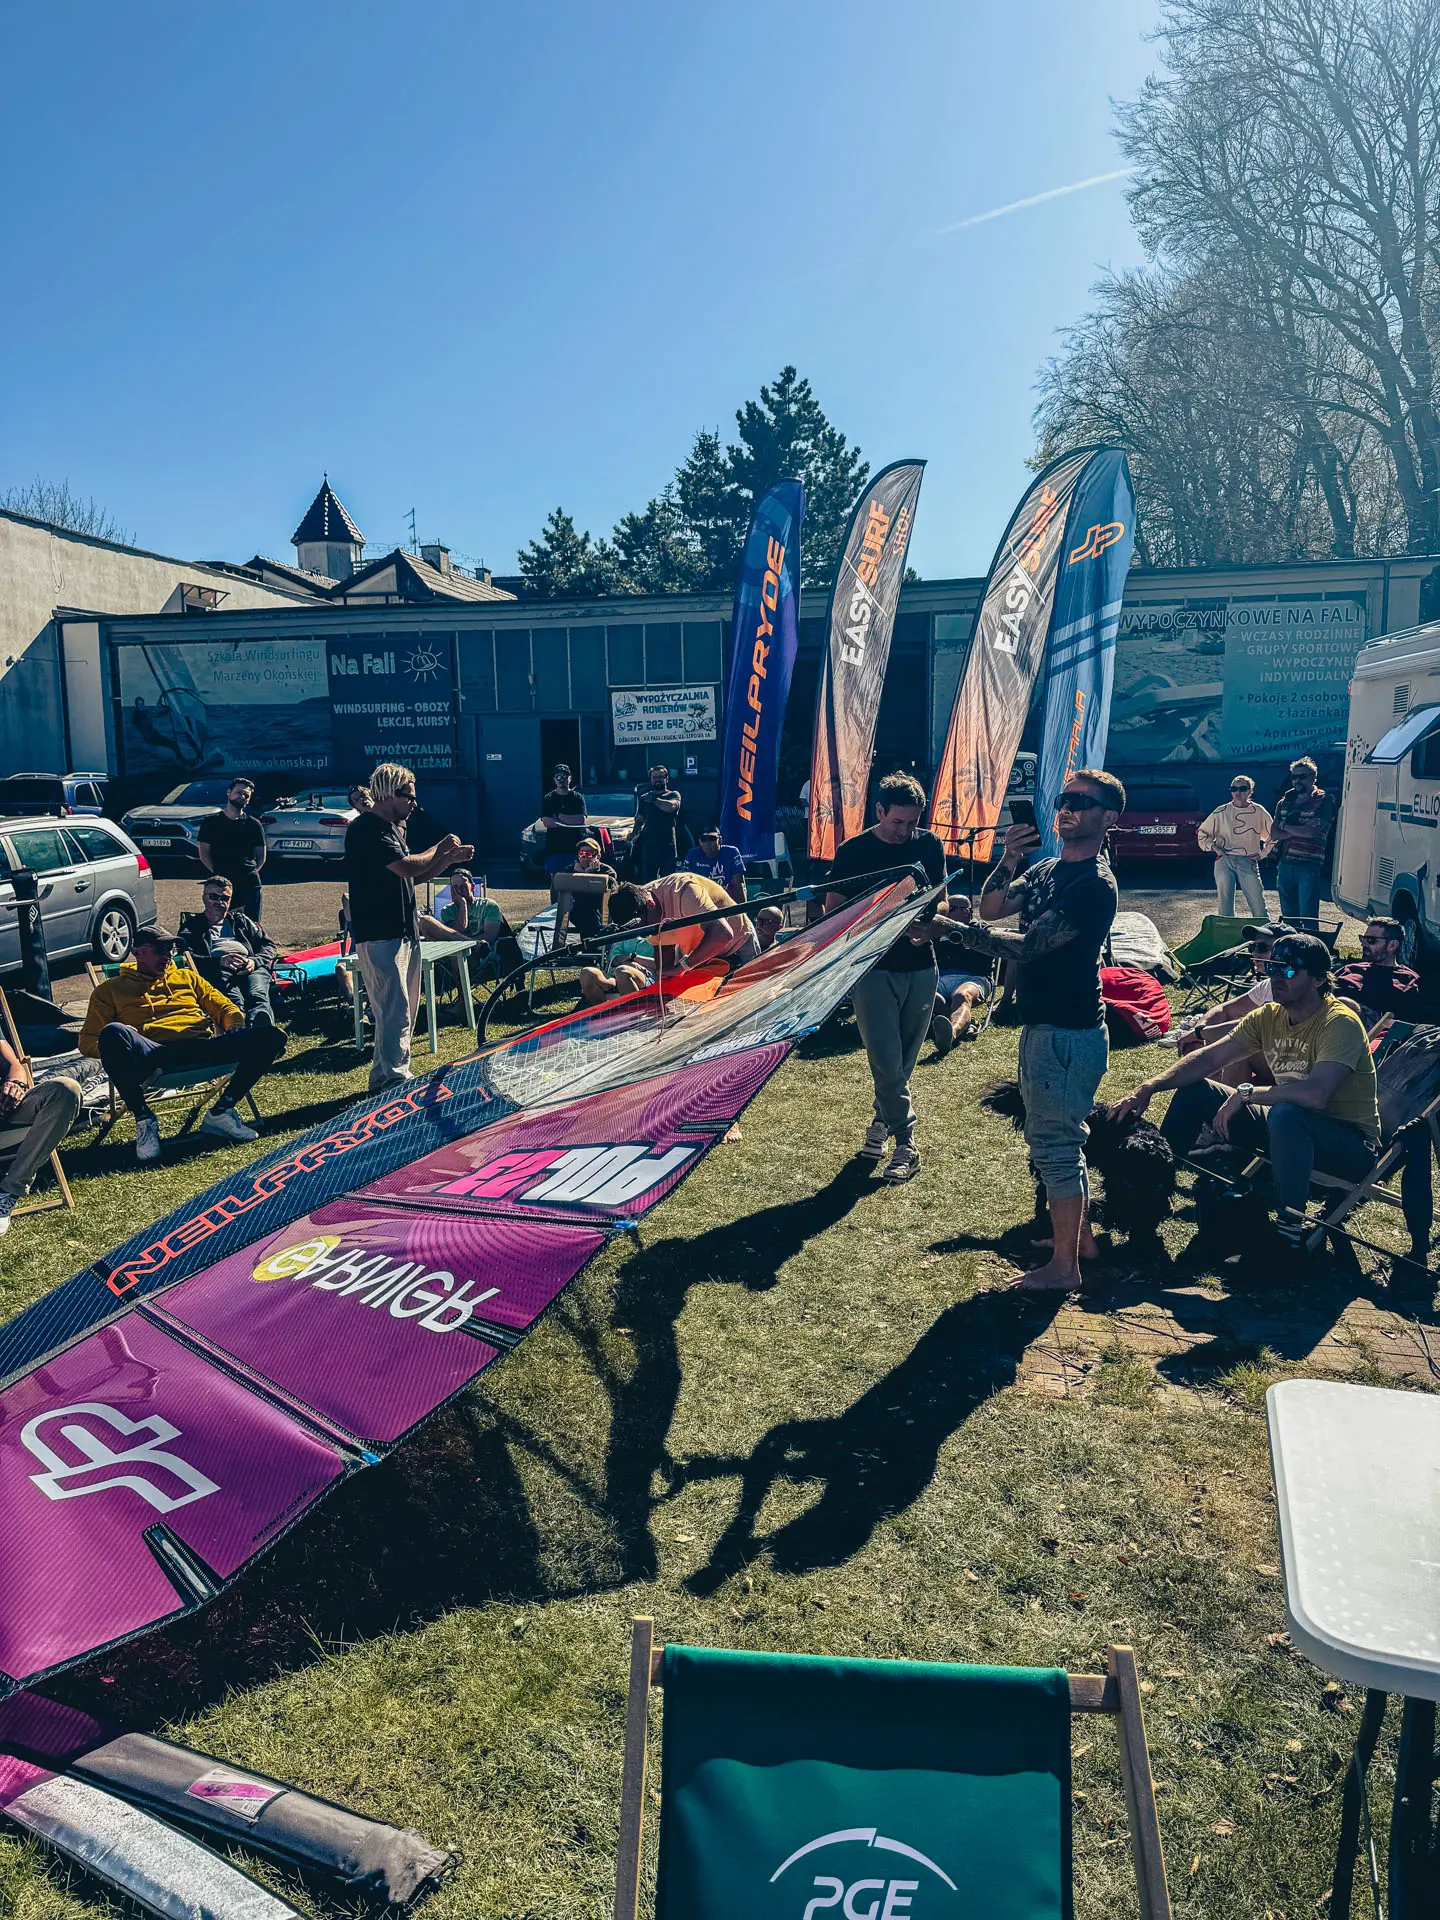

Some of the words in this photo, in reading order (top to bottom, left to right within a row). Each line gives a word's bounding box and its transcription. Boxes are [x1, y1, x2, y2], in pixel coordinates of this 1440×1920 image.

[892, 506, 911, 556] SHOP
[1120, 609, 1282, 629] WYPOCZYNKOWE
[1287, 608, 1315, 625] NA
[1320, 606, 1361, 623] FALI
[1241, 630, 1292, 641] WCZASY
[1296, 628, 1360, 640] RODZINNE
[244, 647, 320, 662] Windsurfingu
[1247, 644, 1289, 656] GRUPY
[1291, 642, 1358, 654] SPORTOWE
[330, 654, 360, 676] Na
[363, 652, 396, 675] Fali
[213, 669, 260, 683] Marzeny
[263, 667, 317, 682] Okońskiej
[737, 536, 785, 820] NEILPRYDE
[635, 690, 710, 703] WYPOŻYCZALNIA
[1247, 692, 1288, 706] Pokoje
[1290, 692, 1297, 703] 2
[1301, 690, 1350, 703] osobow
[333, 703, 405, 714] WINDSURFING
[414, 701, 450, 713] OBOZY
[642, 702, 687, 715] ROWERÓW
[1287, 706, 1350, 719] łazienkam
[377, 716, 415, 728] LEKCJE,
[416, 716, 450, 727] KURSY
[626, 721, 644, 732] 575
[646, 720, 664, 730] 282
[666, 719, 684, 730] 642
[1263, 725, 1345, 740] Apartamenty
[363, 742, 452, 755] WYPOŻYCZALNIA
[417, 756, 452, 769] LEŻAKI
[686, 757, 695, 768] P
[106, 1082, 454, 1297] NEILPRYDE
[802, 1876, 919, 1920] PGE
